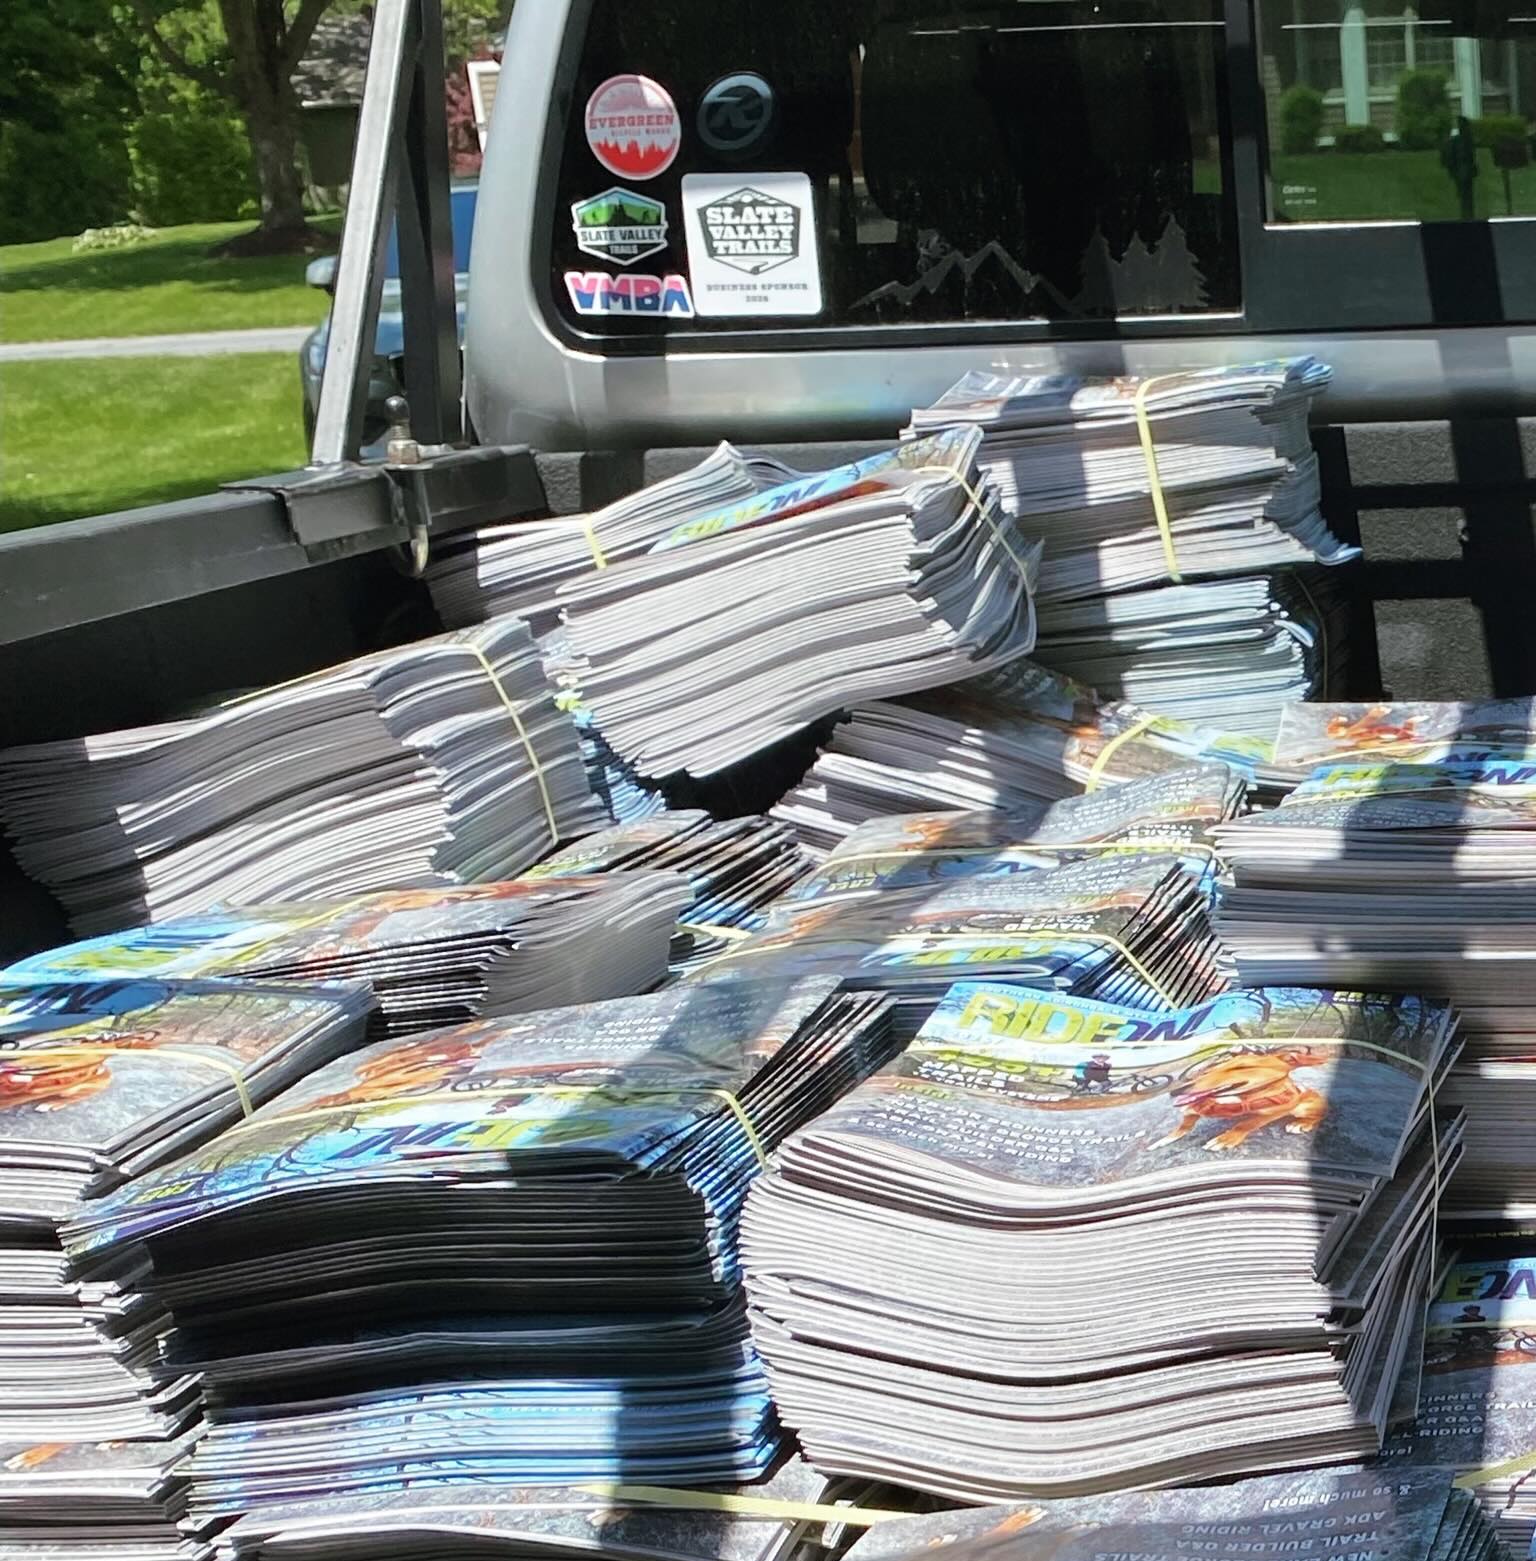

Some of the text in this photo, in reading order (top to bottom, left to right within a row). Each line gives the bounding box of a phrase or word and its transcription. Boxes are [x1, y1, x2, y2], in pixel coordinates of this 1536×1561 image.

[589, 114, 675, 130] EVERGREEN
[706, 206, 794, 224] SLATE
[580, 227, 663, 242] SLATE VALLEY
[708, 225, 795, 240] VALLEY
[609, 244, 638, 255] TRAILS
[712, 239, 793, 255] TRAILS
[568, 275, 691, 312] VMBA
[1262, 1484, 1412, 1512] & so much more!
[1181, 1510, 1386, 1537] ADK GRAVEL RIDING
[1175, 1530, 1378, 1553] TRAIL BUILDER Q&A
